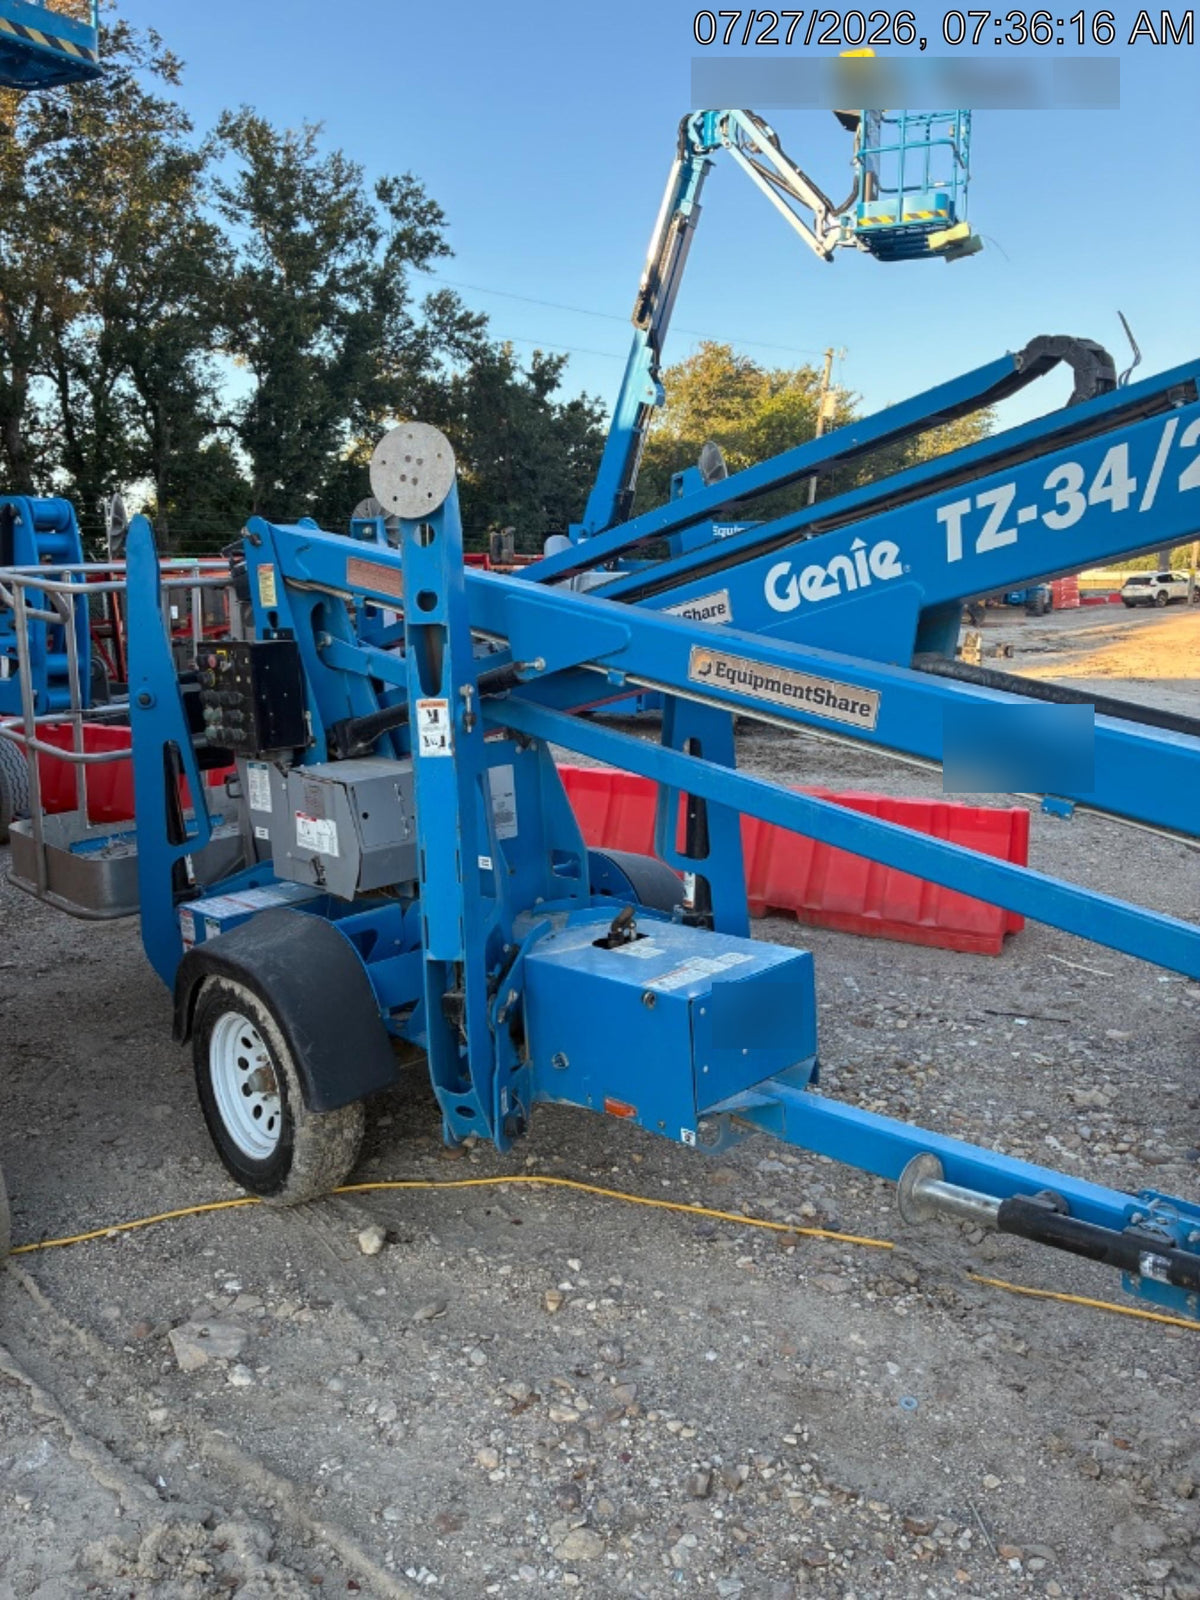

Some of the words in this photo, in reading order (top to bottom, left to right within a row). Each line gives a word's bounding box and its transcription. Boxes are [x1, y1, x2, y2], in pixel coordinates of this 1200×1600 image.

[764, 537, 904, 612] Genie
[677, 603, 727, 621] Share
[714, 660, 871, 717] EquipmentShare
